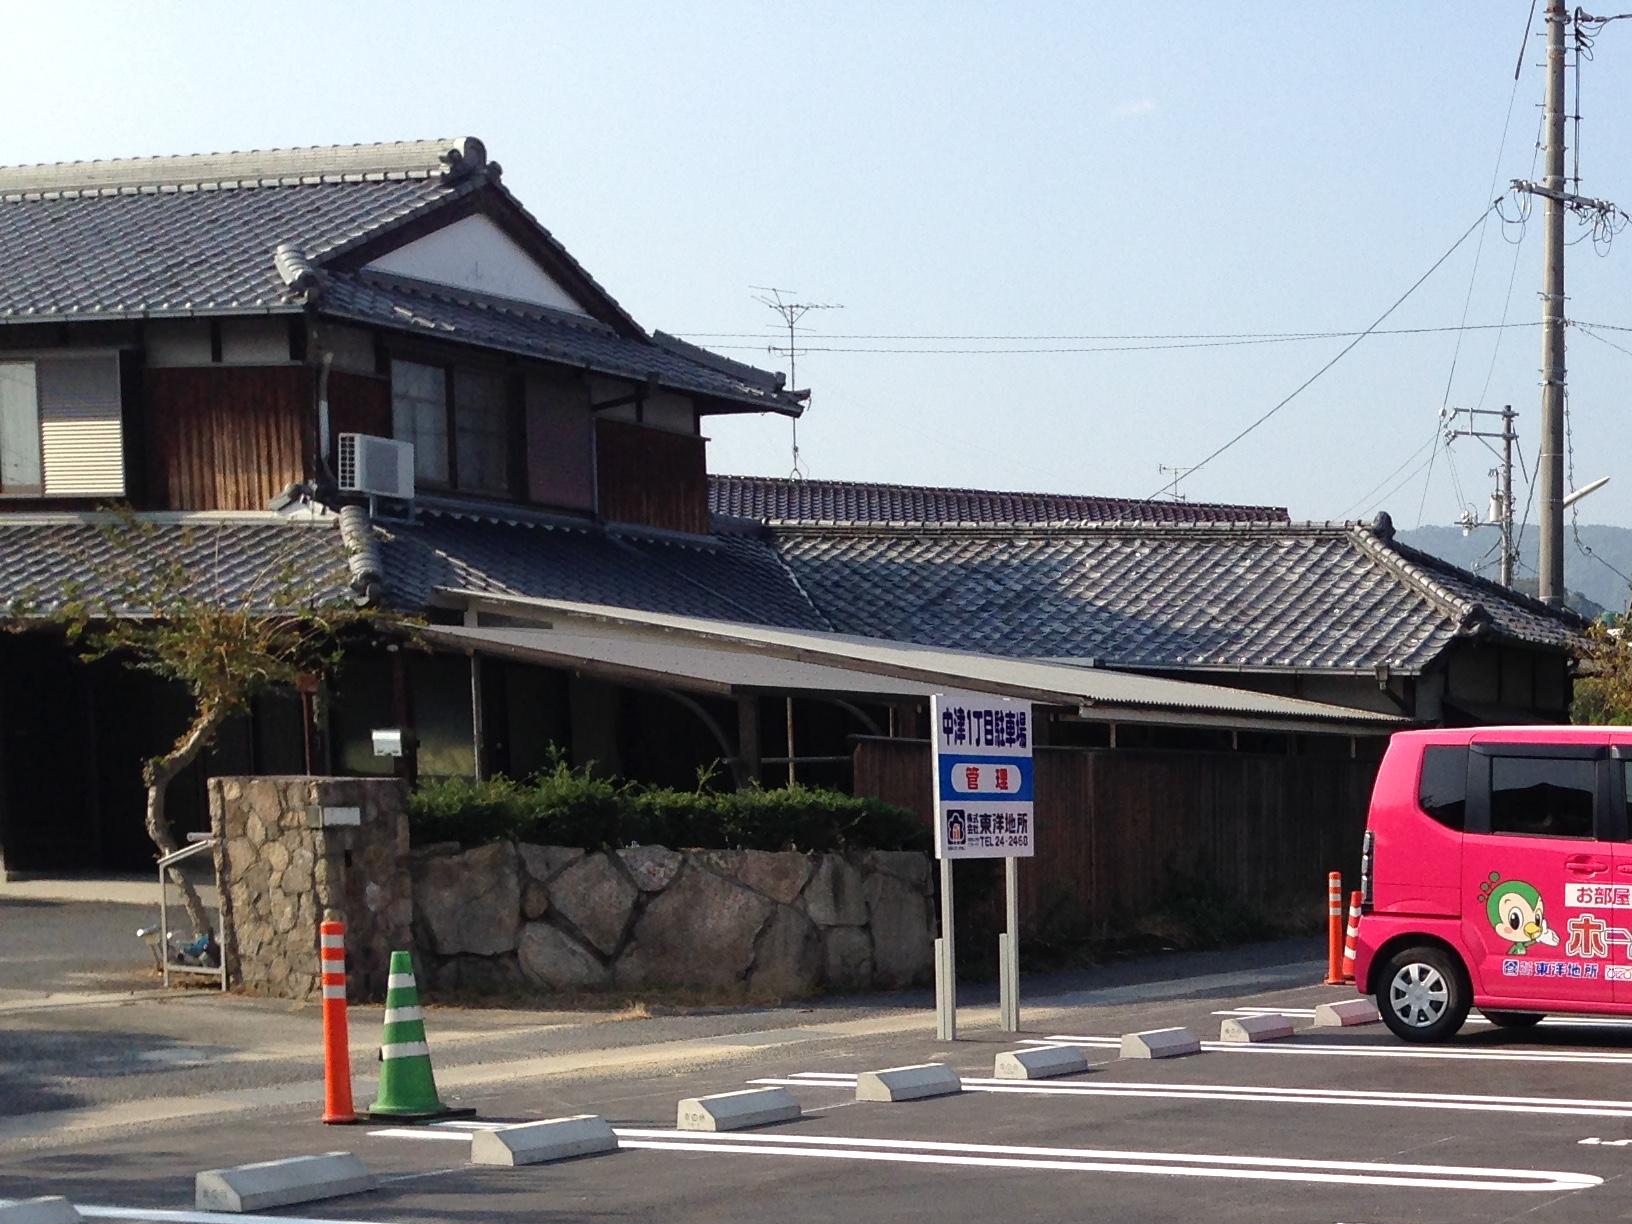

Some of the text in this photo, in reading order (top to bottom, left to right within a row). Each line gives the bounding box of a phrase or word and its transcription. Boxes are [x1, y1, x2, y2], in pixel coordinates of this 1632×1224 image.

[966, 767, 1009, 790] 管理
[980, 836, 994, 847] TEL
[1534, 962, 1599, 979] 東洋地所
